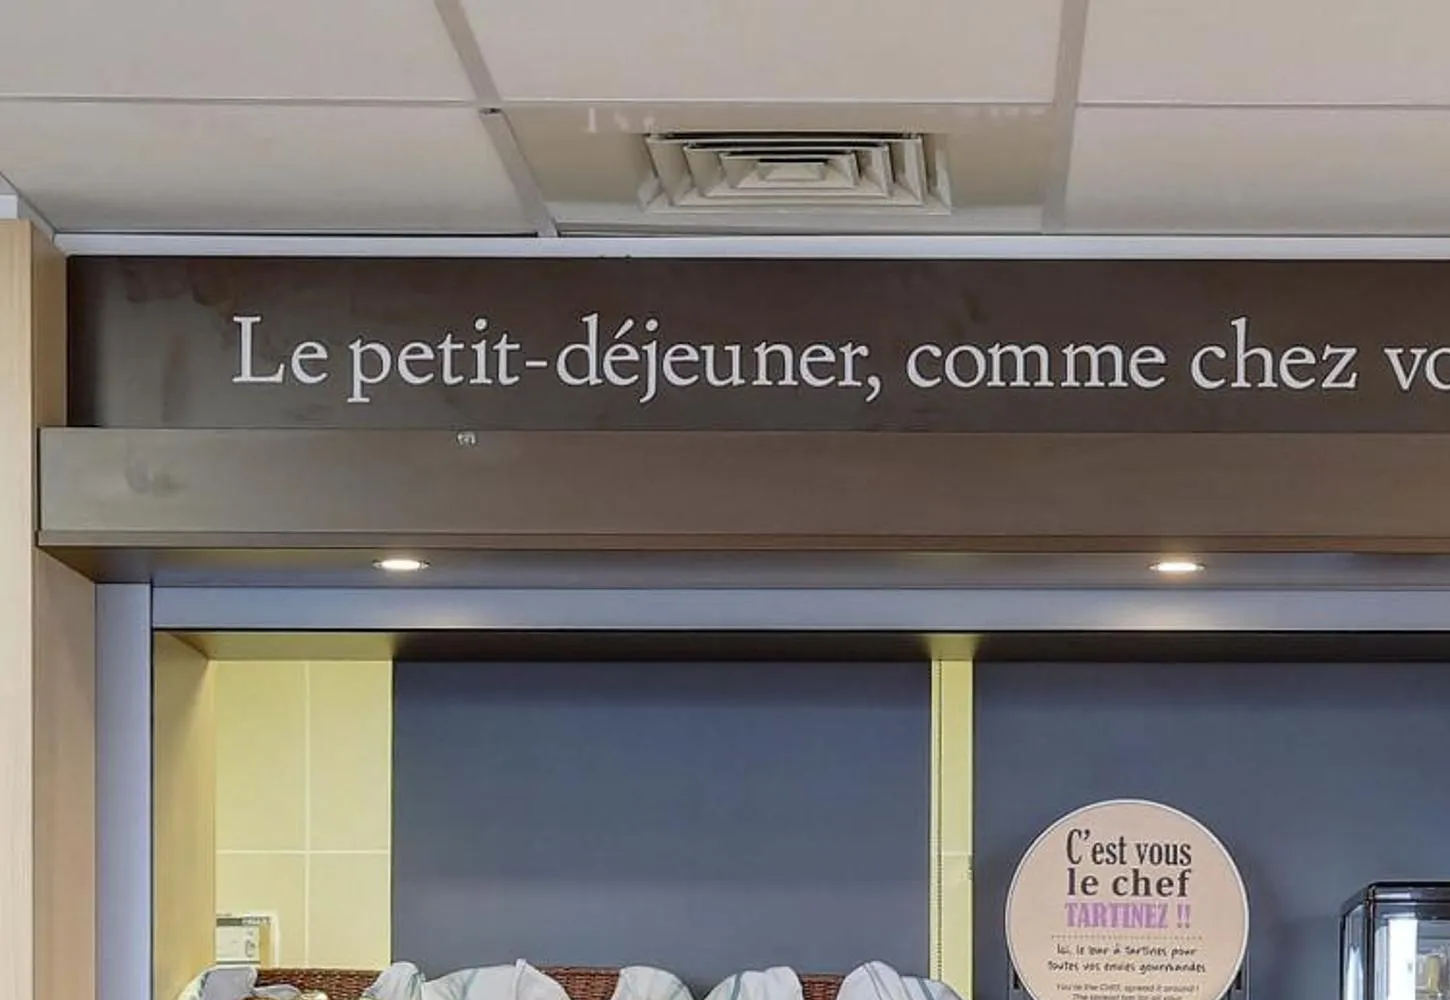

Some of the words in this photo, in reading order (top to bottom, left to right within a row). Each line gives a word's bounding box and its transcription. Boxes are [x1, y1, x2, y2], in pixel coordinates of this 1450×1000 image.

[232, 315, 328, 386] Le
[347, 313, 882, 403] petit-déjeuner,
[906, 343, 1167, 389] comme
[1190, 317, 1360, 391] chez
[1135, 842, 1192, 866] vous
[1066, 867, 1100, 897] le
[1111, 868, 1192, 898] chef
[1065, 903, 1168, 929] TARTINEZ
[1138, 962, 1206, 975] gourmandes
